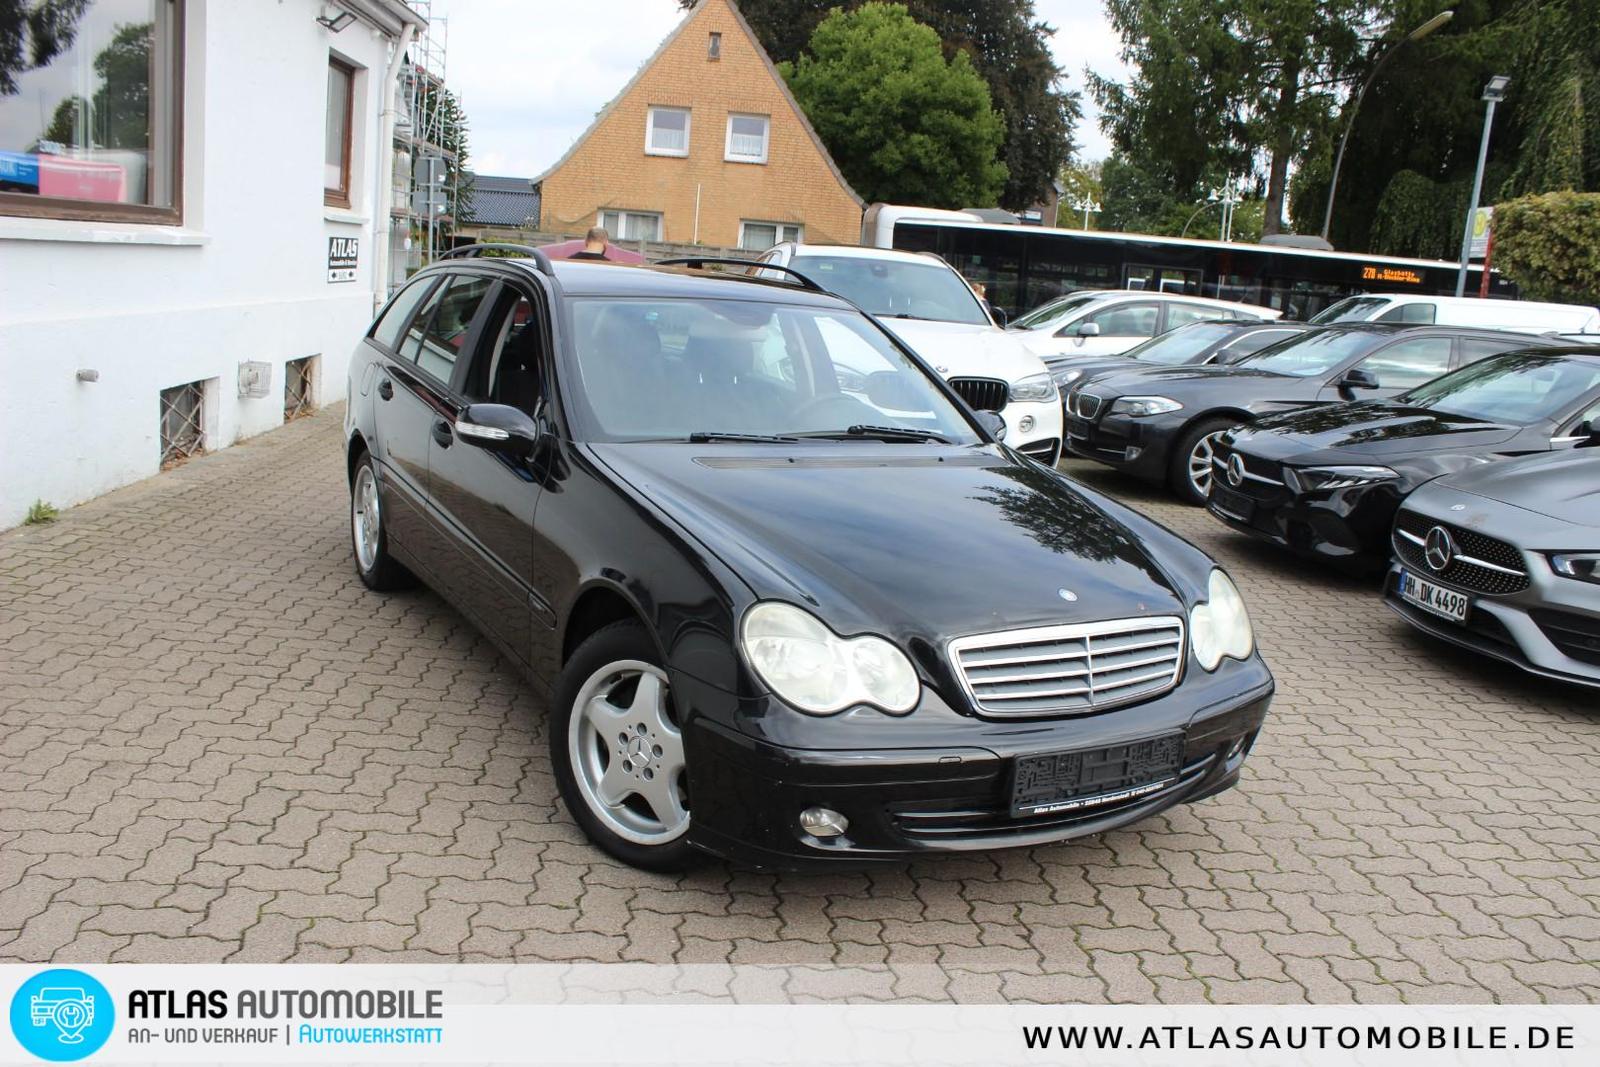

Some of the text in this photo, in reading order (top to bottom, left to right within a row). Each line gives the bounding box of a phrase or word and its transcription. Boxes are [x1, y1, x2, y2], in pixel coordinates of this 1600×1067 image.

[330, 238, 359, 258] ATLAS
[1405, 574, 1416, 596] HH
[1420, 583, 1434, 606] DK
[1435, 590, 1466, 617] 4498
